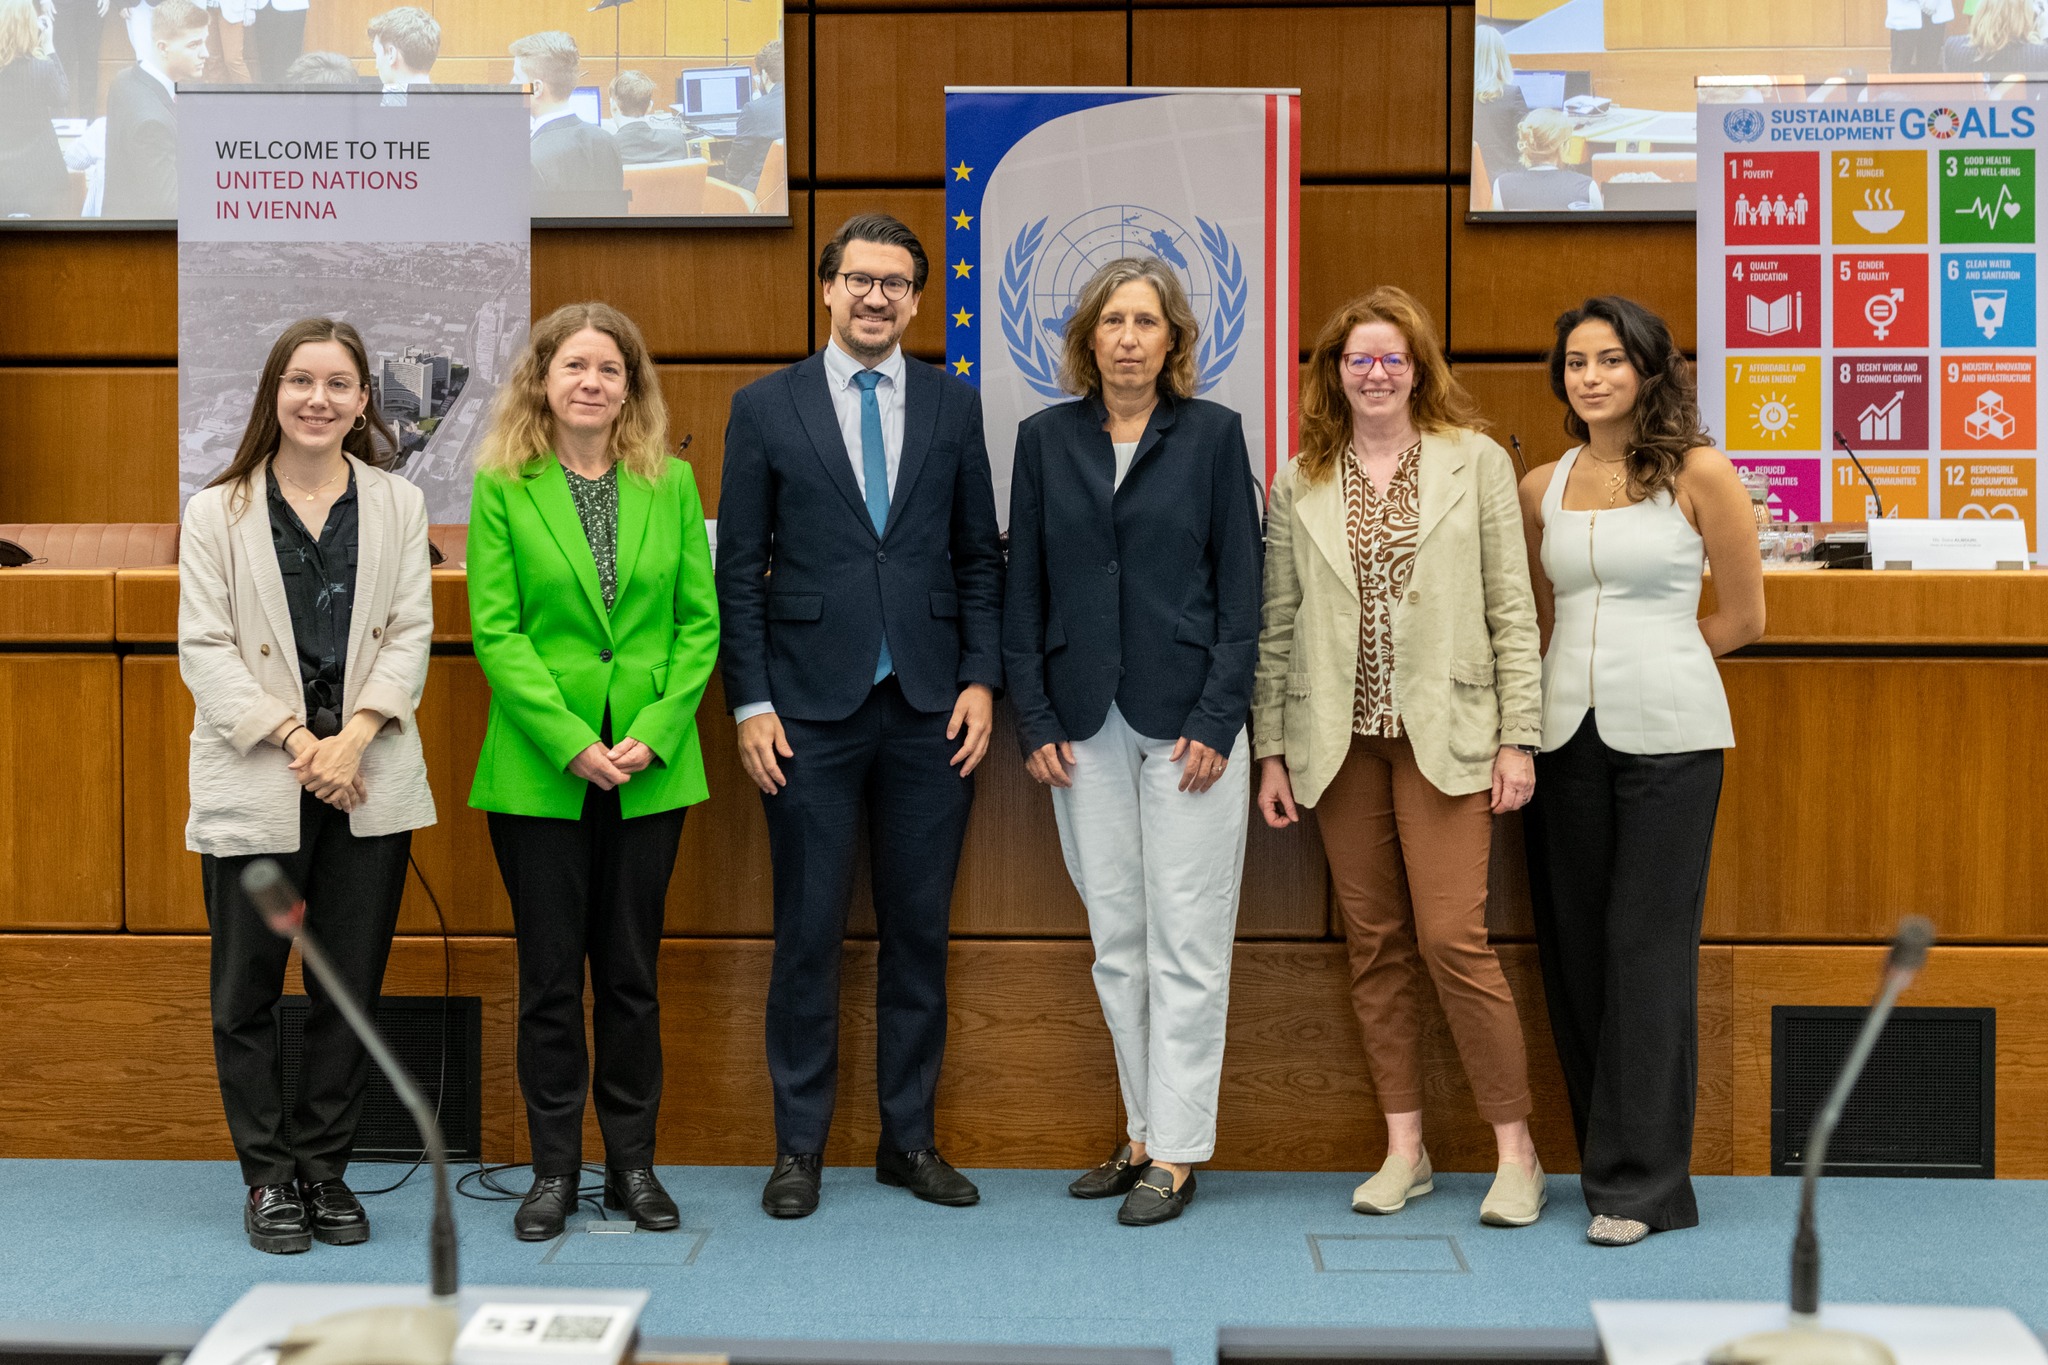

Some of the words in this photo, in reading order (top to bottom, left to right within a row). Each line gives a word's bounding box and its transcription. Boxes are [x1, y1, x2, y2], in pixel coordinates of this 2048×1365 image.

[1771, 108, 1896, 124] SUSTAINABLE
[1771, 126, 1896, 142] DEVELOPMENT
[215, 140, 339, 160] WELCOME
[344, 140, 377, 160] TO
[384, 140, 430, 160] THE
[1743, 158, 1753, 168] NO
[1856, 157, 1874, 167] ZERO
[1964, 156, 1984, 165] GOOD
[1985, 156, 2011, 165] HEALTH
[1729, 159, 1737, 179] 1
[1838, 157, 1850, 178] 2
[1946, 156, 1958, 177] 3
[1964, 167, 1979, 176] AND
[1980, 167, 2021, 176] WELL-BEING
[1743, 170, 1774, 179] POVERTY
[1856, 168, 1884, 178] HUNGER
[215, 170, 304, 190] UNITED
[312, 170, 419, 190] NATIONS
[216, 200, 239, 220] IN
[246, 200, 338, 220] VIENNA
[1750, 261, 1778, 271] QUALITY
[1857, 260, 1884, 270] GENDER
[1965, 259, 1987, 269] CLEAN
[1989, 259, 2011, 269] WATER
[1732, 261, 1744, 282] 4
[1840, 260, 1851, 281] 5
[1947, 260, 1959, 281] 6
[1965, 271, 1980, 280] AND
[1981, 271, 2020, 280] SANITATION
[1750, 272, 1788, 281] EDUCATION
[1857, 272, 1890, 281] EQUALITY
[1749, 363, 1790, 372] AFFORDABLE
[1791, 363, 1806, 372] AND
[1856, 363, 1881, 372] DECENT
[1882, 363, 1902, 372] WORK
[1903, 363, 1918, 372] AND
[1961, 362, 1995, 372] INDUSTRY,
[1995, 362, 2031, 371] INNOVATION
[1733, 363, 1743, 384] 7
[1840, 363, 1851, 383] 8
[1947, 362, 1959, 383] 9
[1749, 374, 1770, 383] CLEAN
[1771, 374, 1797, 384] ENERGY
[1856, 374, 1891, 383] ECONOMIC
[1892, 374, 1922, 383] GROWTH
[1961, 374, 1976, 383] AND
[1976, 374, 2031, 383] INFRASTRUCTURE
[1755, 465, 1785, 474] REDUCED
[1901, 465, 1920, 474] CITIES
[1970, 465, 2014, 474] RESPONSIBLE
[1837, 465, 1853, 486] 11
[1945, 465, 1965, 486] 12
[1769, 477, 1798, 486] UALITIES
[1872, 477, 1917, 486] COMMUNITIES
[1970, 477, 2018, 486] CONSUMPTION
[1970, 488, 1985, 497] AND
[1985, 488, 2028, 497] PRODUCTION
